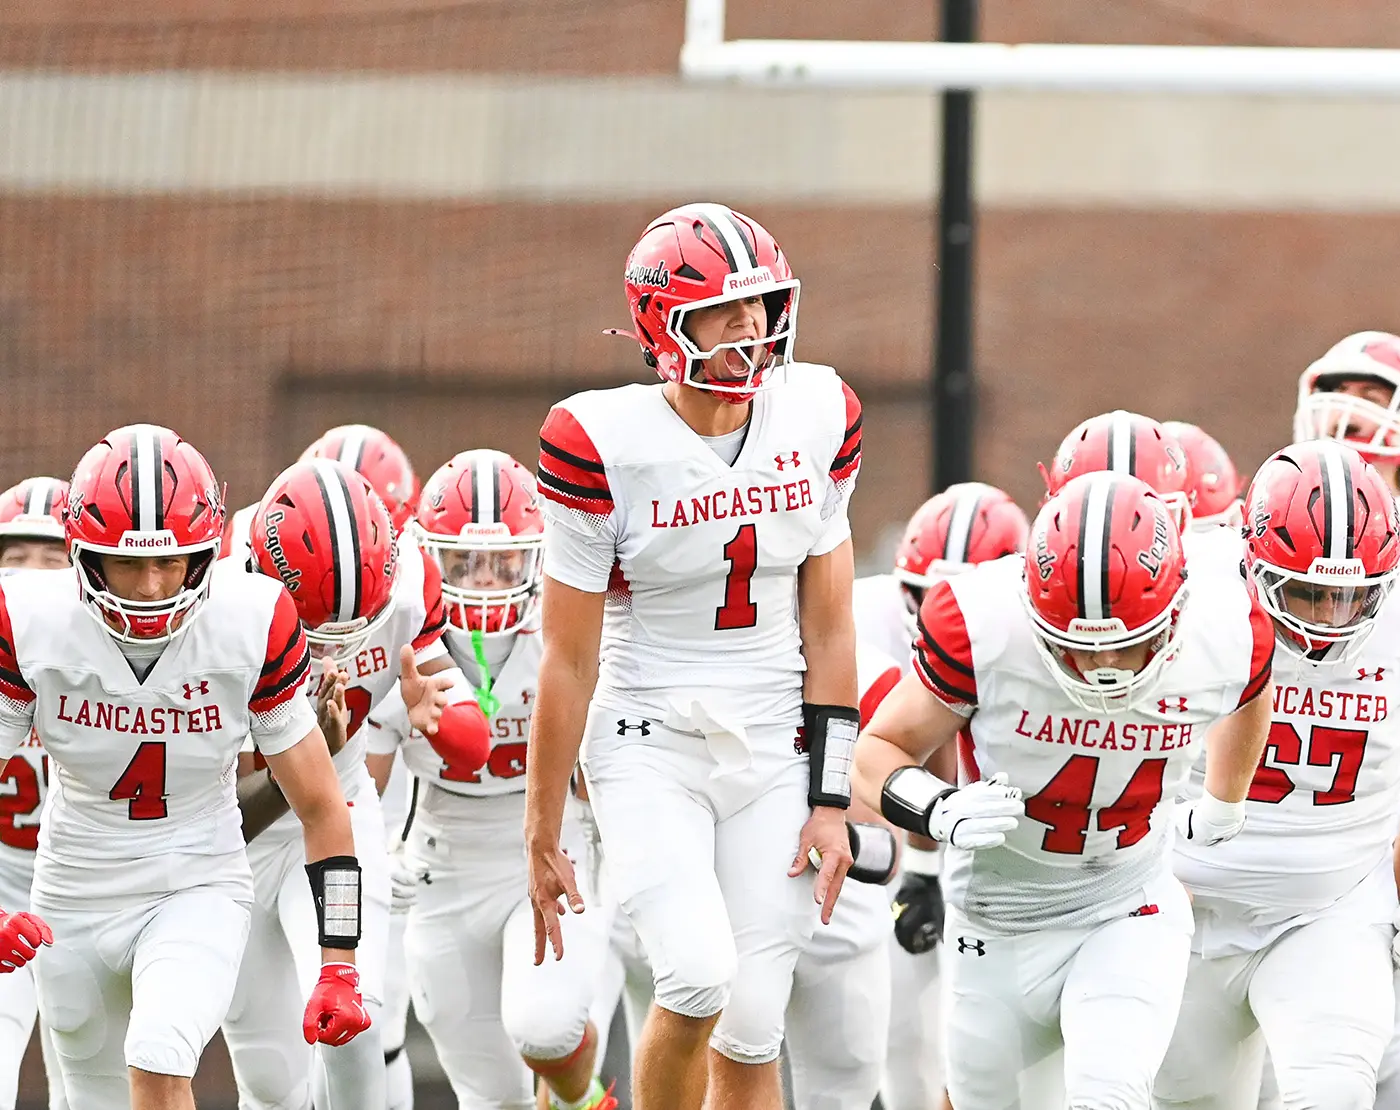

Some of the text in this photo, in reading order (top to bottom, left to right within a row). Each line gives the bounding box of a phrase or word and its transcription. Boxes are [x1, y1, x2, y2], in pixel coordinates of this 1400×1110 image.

[625, 261, 669, 288] egends
[729, 272, 770, 289] Riddell
[651, 479, 813, 528] LANCASTER
[125, 537, 172, 549] Riddell
[265, 511, 301, 592] Legends
[714, 523, 759, 631] 1
[1315, 564, 1361, 576] Riddell
[137, 617, 158, 625] Riddell
[57, 695, 223, 735] LANCASTER
[1272, 685, 1388, 722] NCASTER
[1015, 710, 1193, 751] LANCASTER
[108, 741, 171, 821] 4
[1245, 721, 1369, 806] 67
[0, 755, 48, 852] 2
[1024, 753, 1168, 855] 44
